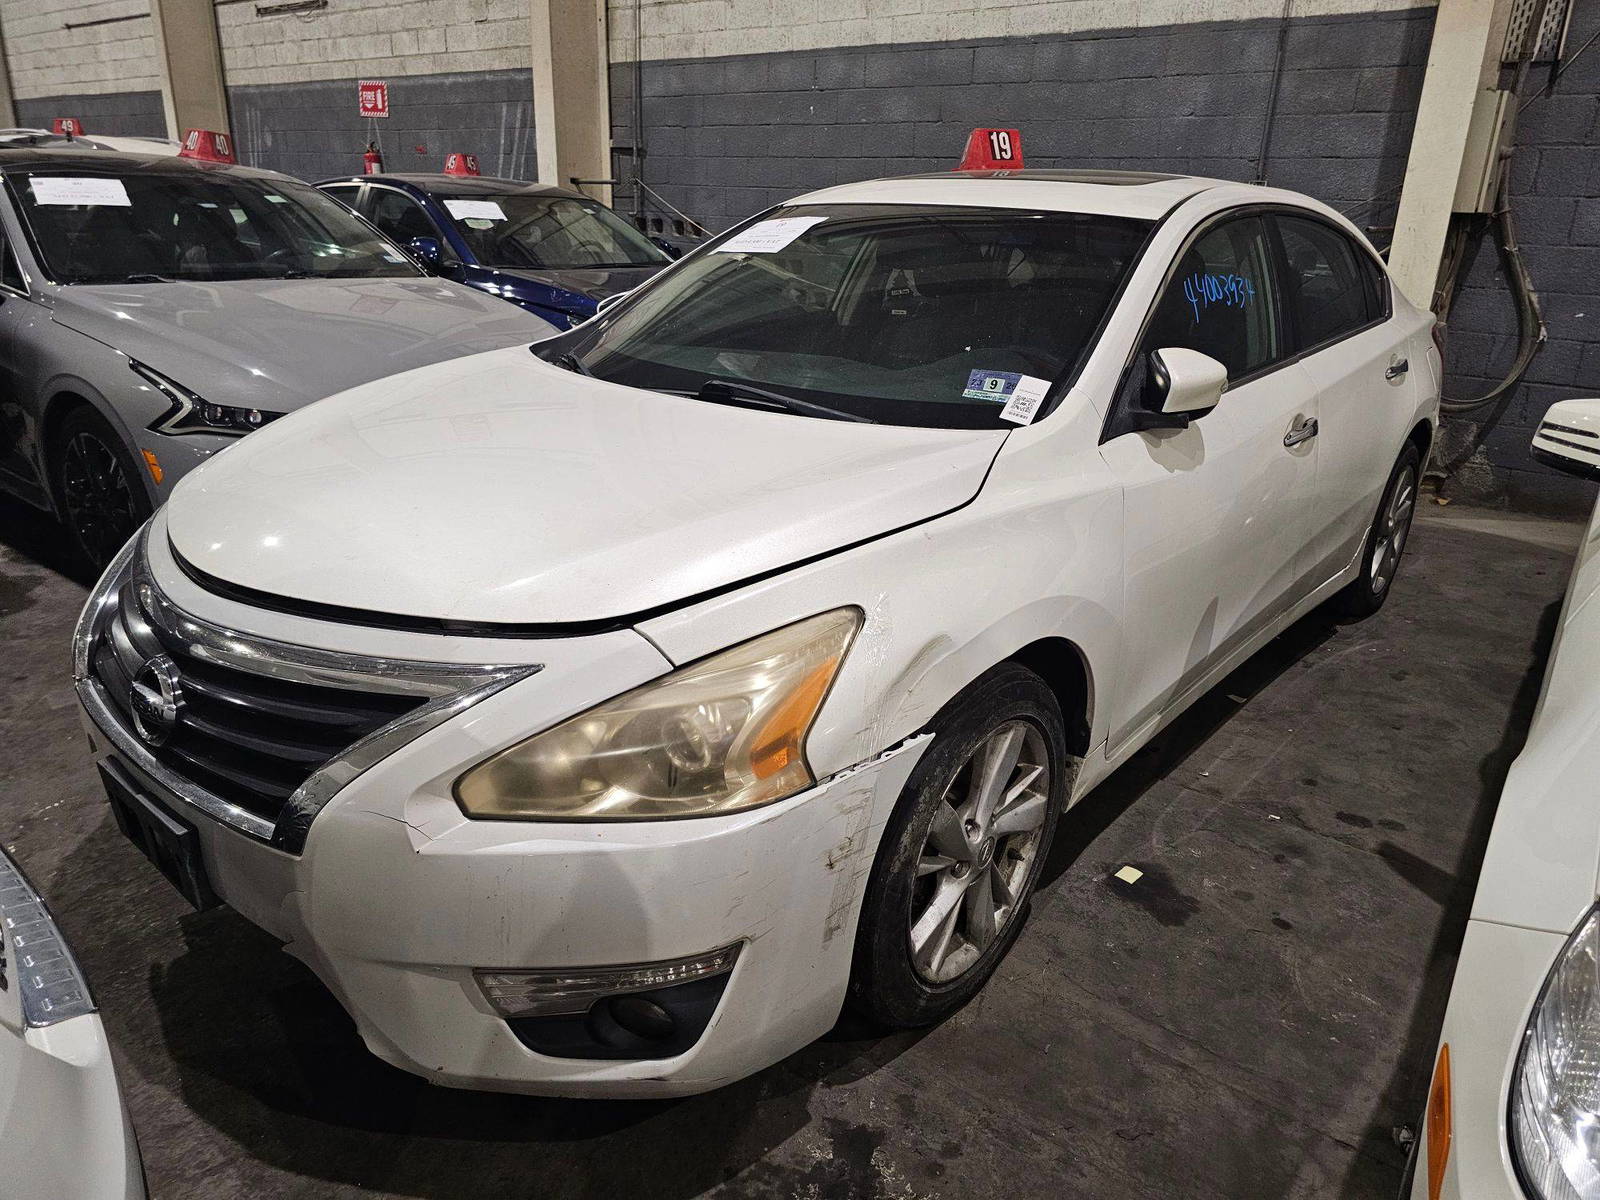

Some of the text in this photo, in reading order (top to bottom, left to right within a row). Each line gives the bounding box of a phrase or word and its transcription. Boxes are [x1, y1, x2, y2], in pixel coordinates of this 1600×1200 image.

[61, 120, 73, 132] 49
[186, 131, 199, 150] 40
[215, 134, 229, 156] 40
[990, 131, 1012, 160] 19
[989, 379, 998, 390] 9
